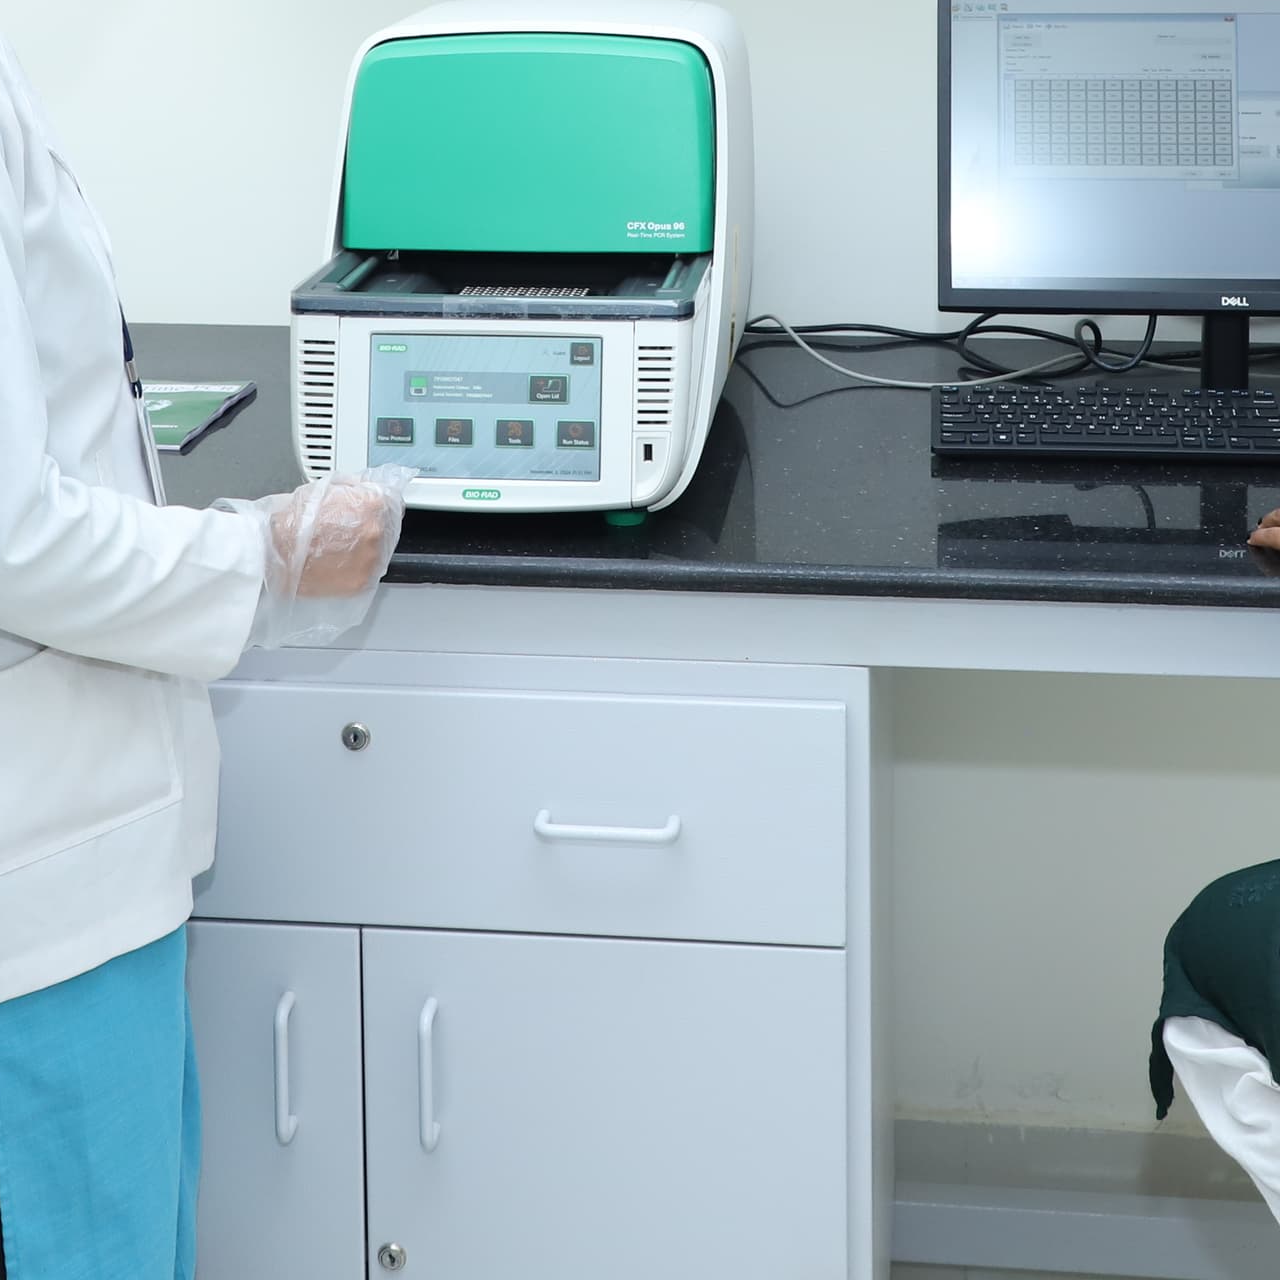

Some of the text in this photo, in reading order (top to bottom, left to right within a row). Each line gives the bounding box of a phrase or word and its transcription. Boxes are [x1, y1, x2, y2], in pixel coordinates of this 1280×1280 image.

[627, 222, 686, 231] CFX Opus 96
[1221, 296, 1249, 307] DELL
